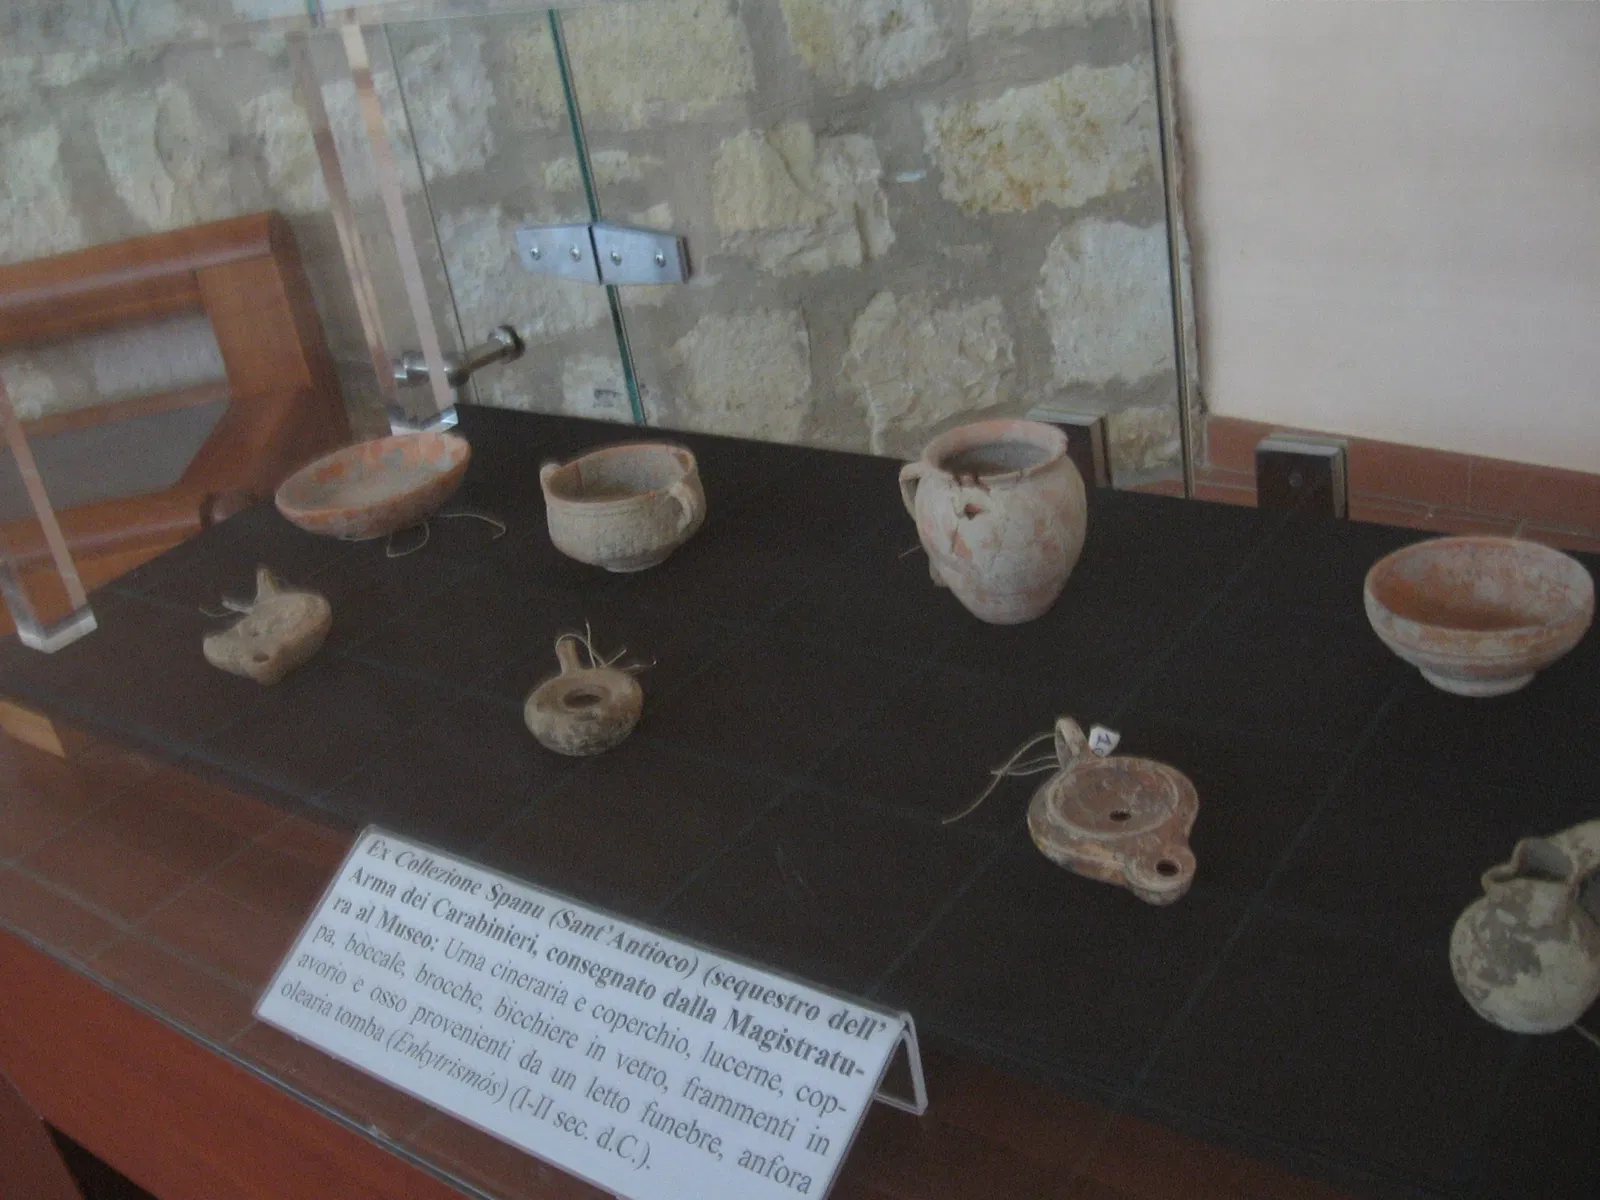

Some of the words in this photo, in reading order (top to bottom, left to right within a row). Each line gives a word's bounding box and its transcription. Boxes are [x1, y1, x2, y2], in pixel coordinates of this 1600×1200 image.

[332, 896, 353, 915] ra
[355, 905, 376, 925] al
[377, 910, 440, 951] Museo:
[443, 938, 487, 972] Urna
[490, 960, 570, 1006] cineraria
[574, 996, 587, 1012] e
[591, 1003, 691, 1060] coperchio,
[700, 1041, 785, 1097] lucerne,
[795, 1085, 847, 1119] cop-
[349, 866, 398, 898] Arma
[400, 886, 428, 911] dei
[432, 898, 539, 957] Carabinieri,
[546, 945, 657, 1000] consegnato
[662, 986, 718, 1025] dalla
[723, 1008, 866, 1078] Magistratu-
[366, 839, 387, 861] Ex
[394, 850, 483, 896] Collezione
[485, 883, 546, 920] Spanu
[548, 908, 699, 980] (Sant'Antioco)
[702, 964, 821, 1021] (sequestro
[280, 980, 334, 1017] olearia
[334, 1004, 386, 1043] tomba
[508, 1084, 555, 1121] (I-II
[552, 1109, 589, 1140] sec.
[595, 1126, 651, 1171] d.C.).
[297, 954, 348, 986] avorio
[352, 978, 363, 993] e
[370, 986, 408, 1013] osso
[409, 1004, 516, 1062] provenienti
[519, 1049, 543, 1076] da
[550, 1066, 578, 1091] un
[584, 1076, 631, 1114] letto
[639, 1100, 725, 1161] funebre,
[737, 1147, 814, 1196] anfora
[312, 922, 336, 947] pa,
[344, 932, 406, 978] boccale,
[415, 963, 484, 1013] brocche,
[493, 996, 579, 1049] bicchiere
[585, 1034, 607, 1062] in
[616, 1052, 669, 1095] vetro,
[681, 1075, 800, 1142] frammenti
[806, 1125, 831, 1157] in
